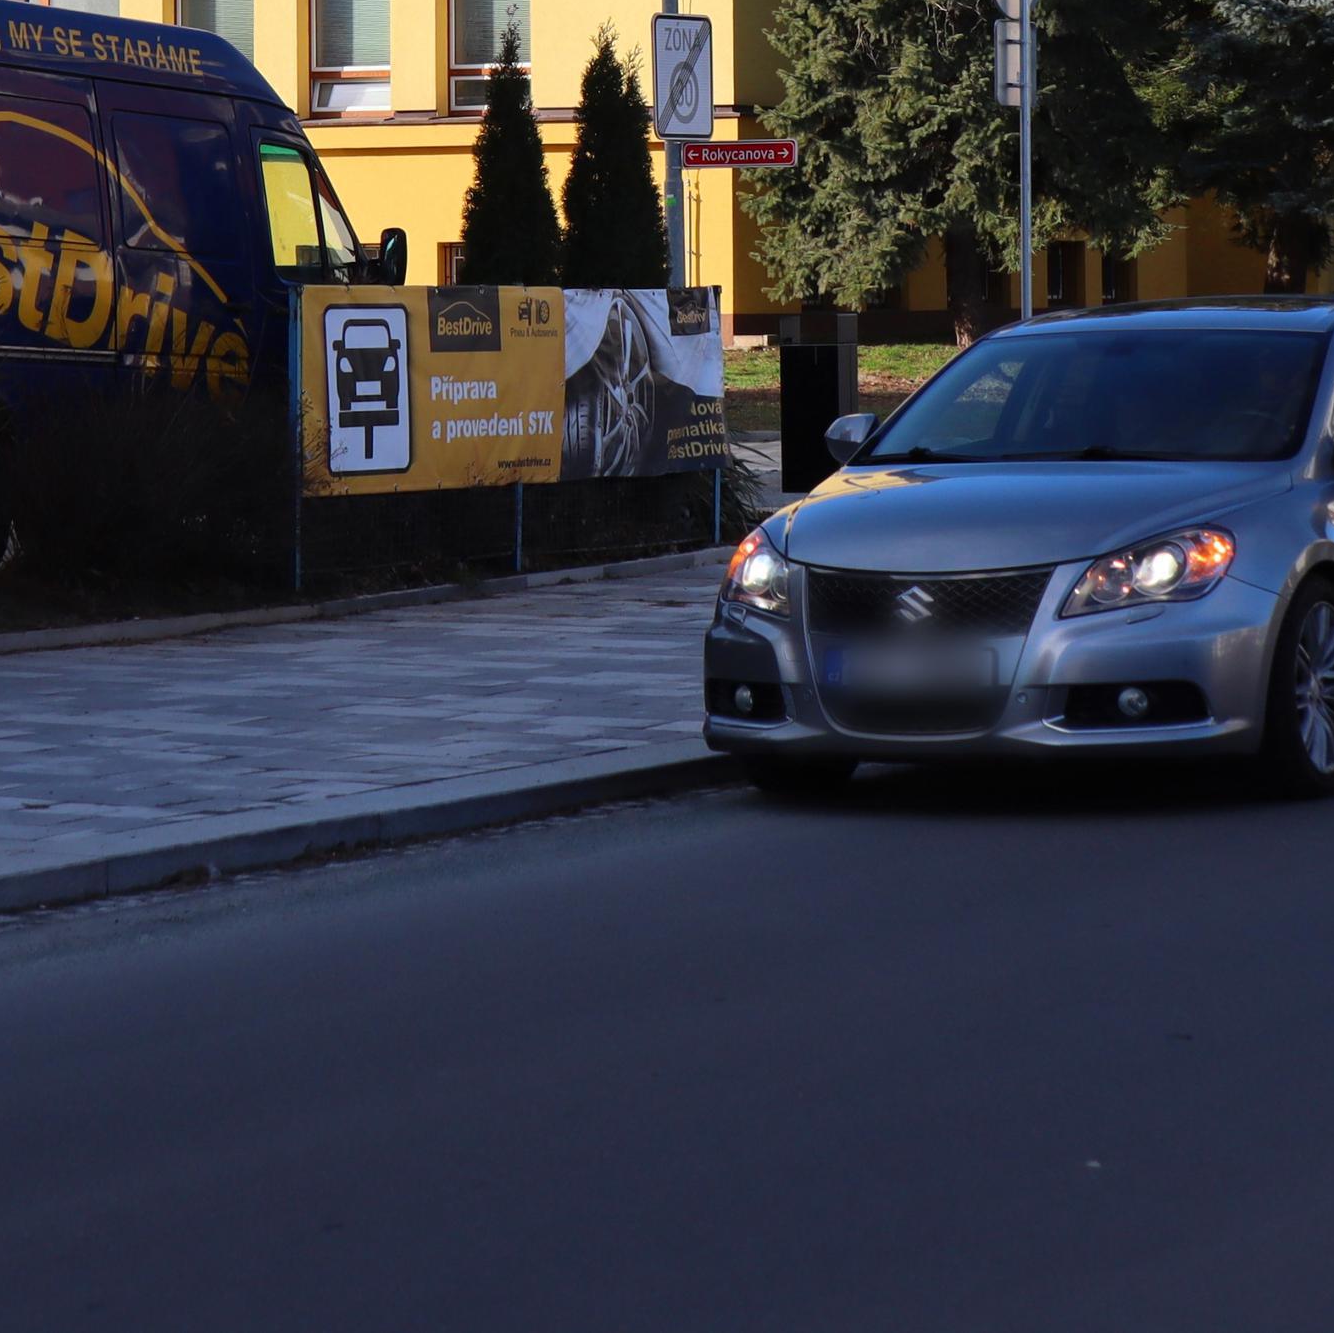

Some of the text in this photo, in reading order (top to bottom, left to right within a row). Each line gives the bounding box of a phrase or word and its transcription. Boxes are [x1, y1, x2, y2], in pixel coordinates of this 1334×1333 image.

[8, 20, 44, 52] MY
[53, 26, 85, 58] SE
[93, 35, 204, 76] STARÁME
[701, 147, 776, 164] Rokycanova
[437, 316, 493, 336] BestDrive
[430, 376, 497, 405] Příprava
[432, 411, 555, 443] a provedení STK
